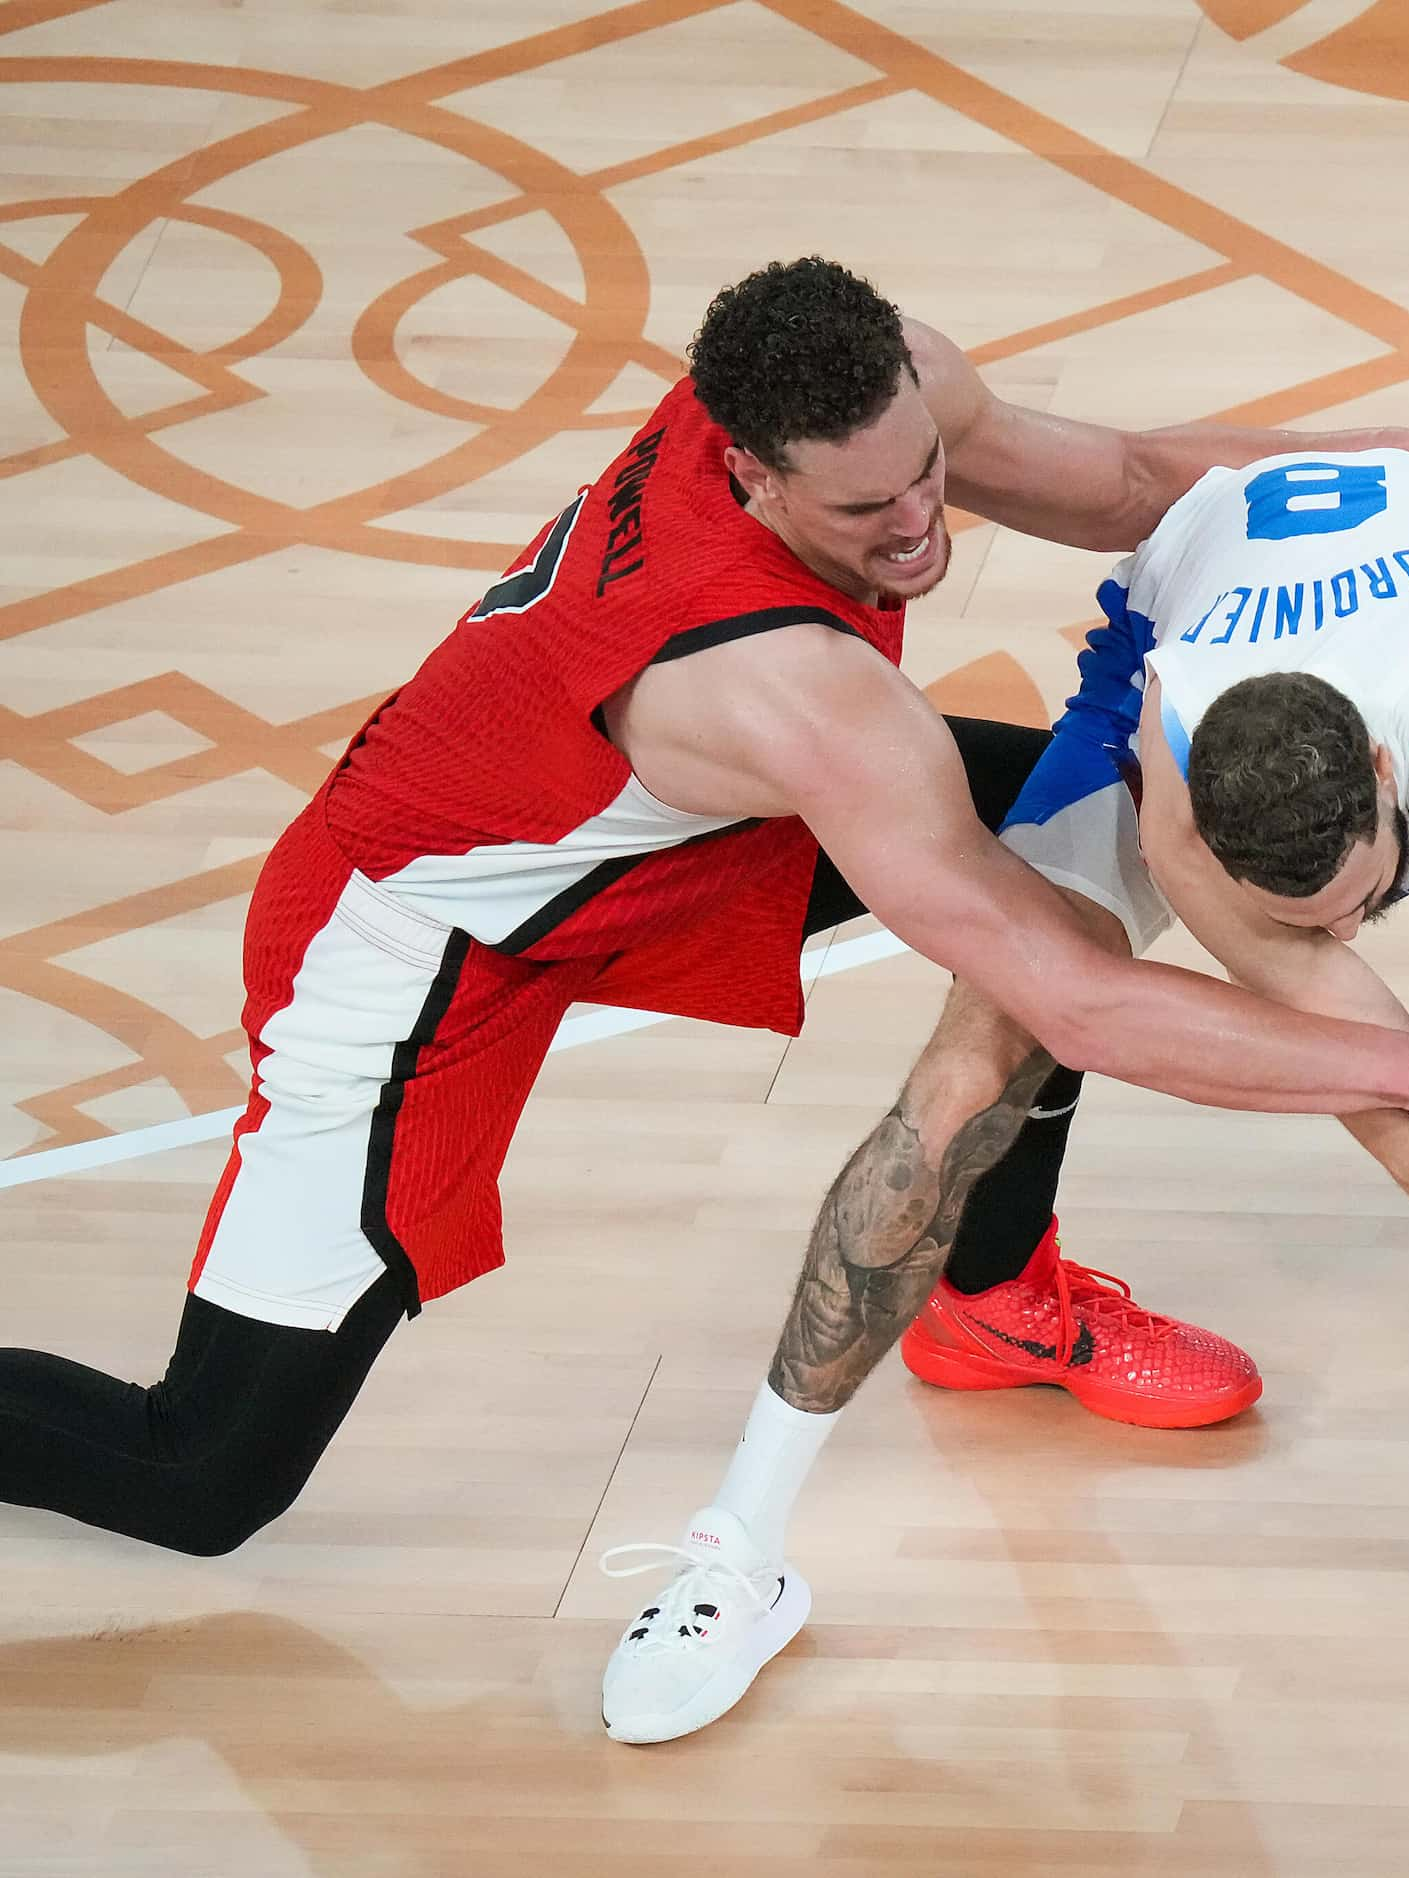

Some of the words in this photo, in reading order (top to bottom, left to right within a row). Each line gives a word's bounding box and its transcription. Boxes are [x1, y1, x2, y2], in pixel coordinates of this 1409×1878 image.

[596, 426, 668, 598] POWELL
[1244, 461, 1388, 541] 8
[691, 1531, 721, 1545] KIPSTA
